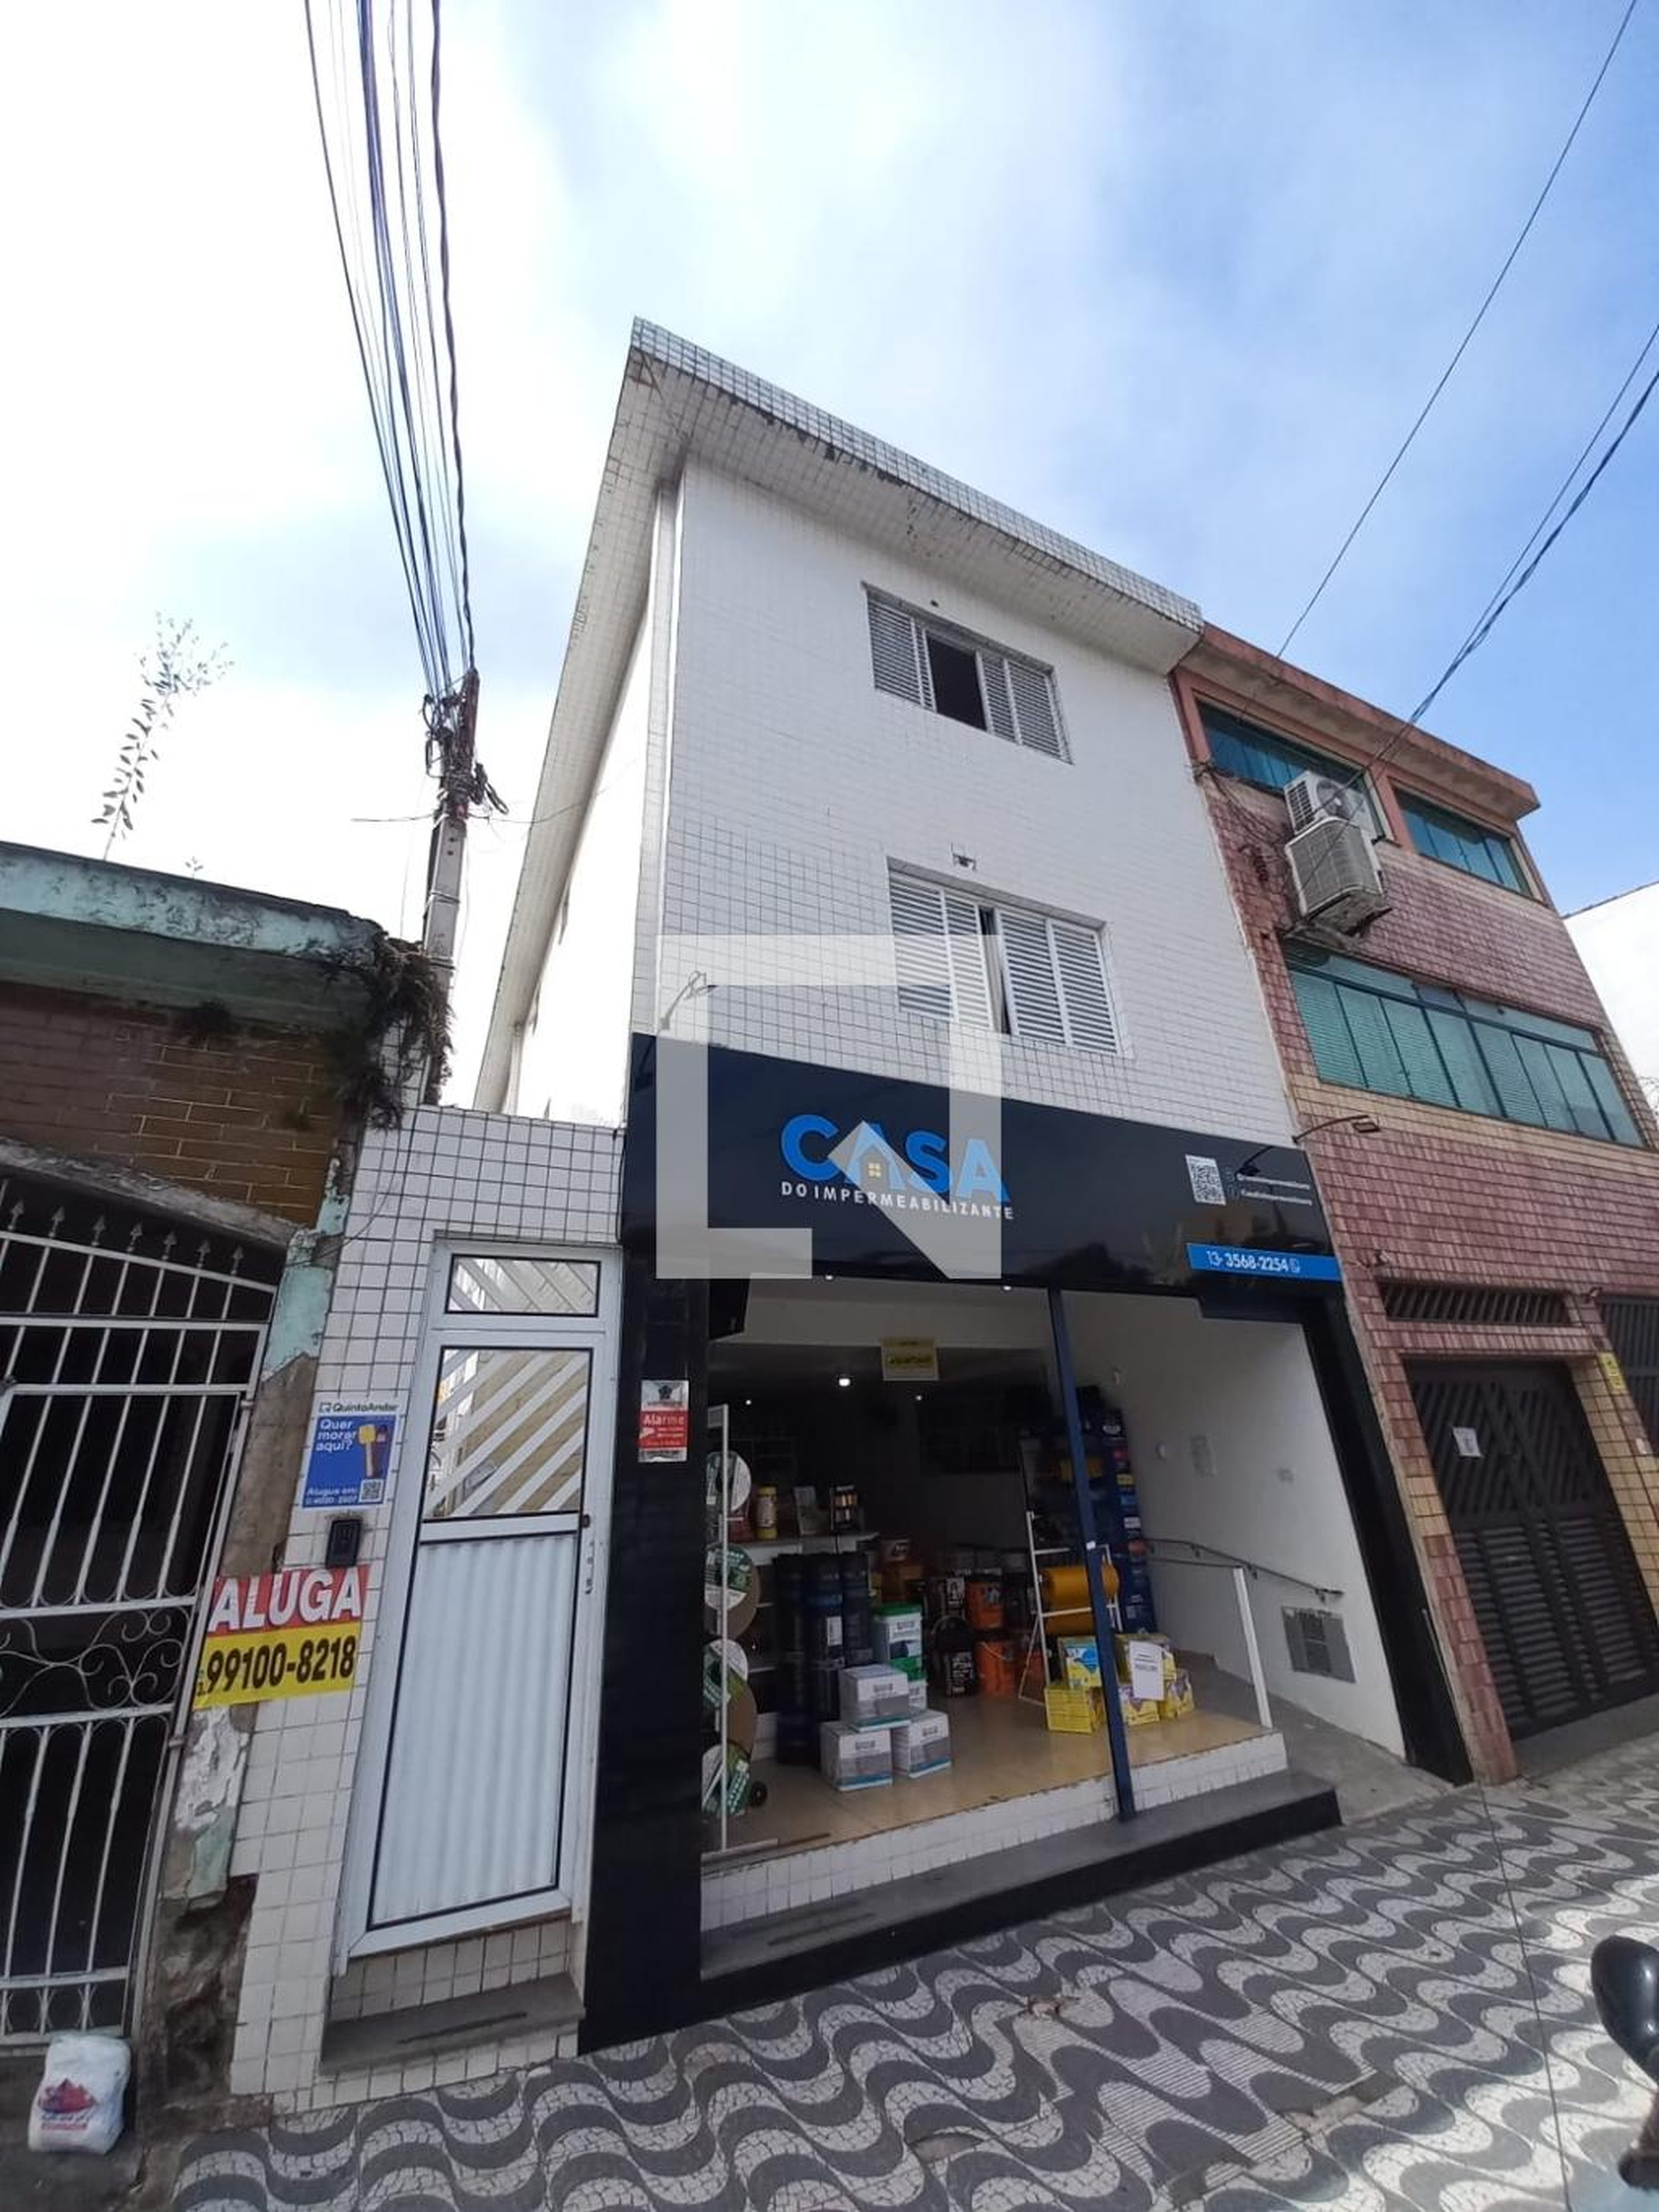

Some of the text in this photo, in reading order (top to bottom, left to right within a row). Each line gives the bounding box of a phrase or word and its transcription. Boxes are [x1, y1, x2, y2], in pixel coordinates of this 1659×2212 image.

[781, 1114, 1011, 1202] CASA
[781, 1181, 1014, 1219] DO IMPERMEABILIZANTE
[320, 1418, 353, 1430] Quer
[644, 1413, 684, 1426] Alarme
[315, 1439, 353, 1452] aqui?
[207, 1567, 361, 1633] ALUGA
[207, 1636, 356, 1693] 99100-8218
